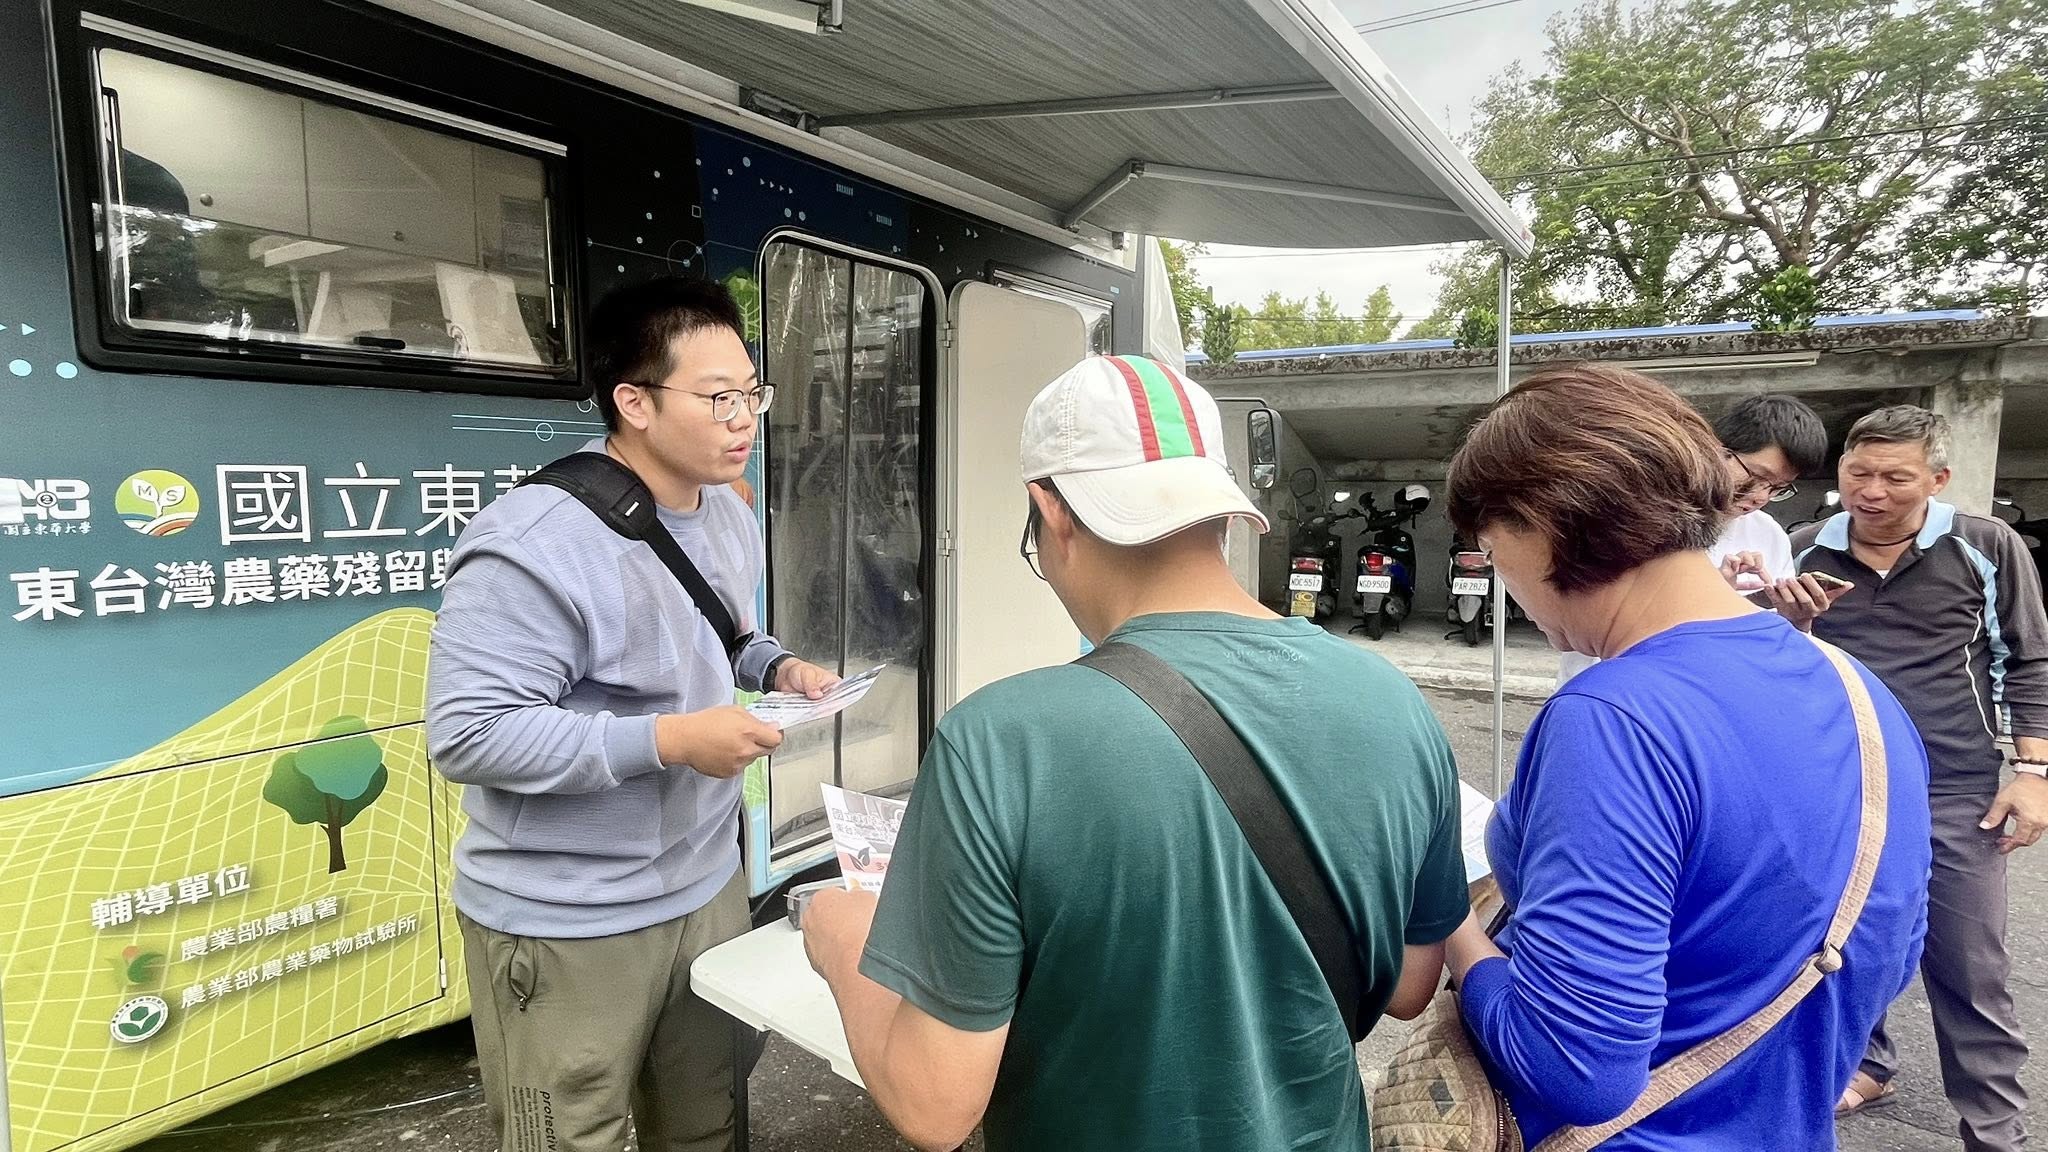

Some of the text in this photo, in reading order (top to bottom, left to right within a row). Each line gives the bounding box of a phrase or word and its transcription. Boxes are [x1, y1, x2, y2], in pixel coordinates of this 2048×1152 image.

[90, 862, 251, 930] 輔導單位
[181, 896, 338, 961] 農業部農糧署
[181, 914, 417, 1009] 農業部農業藥物試驗所
[540, 1090, 558, 1152] protectiv
